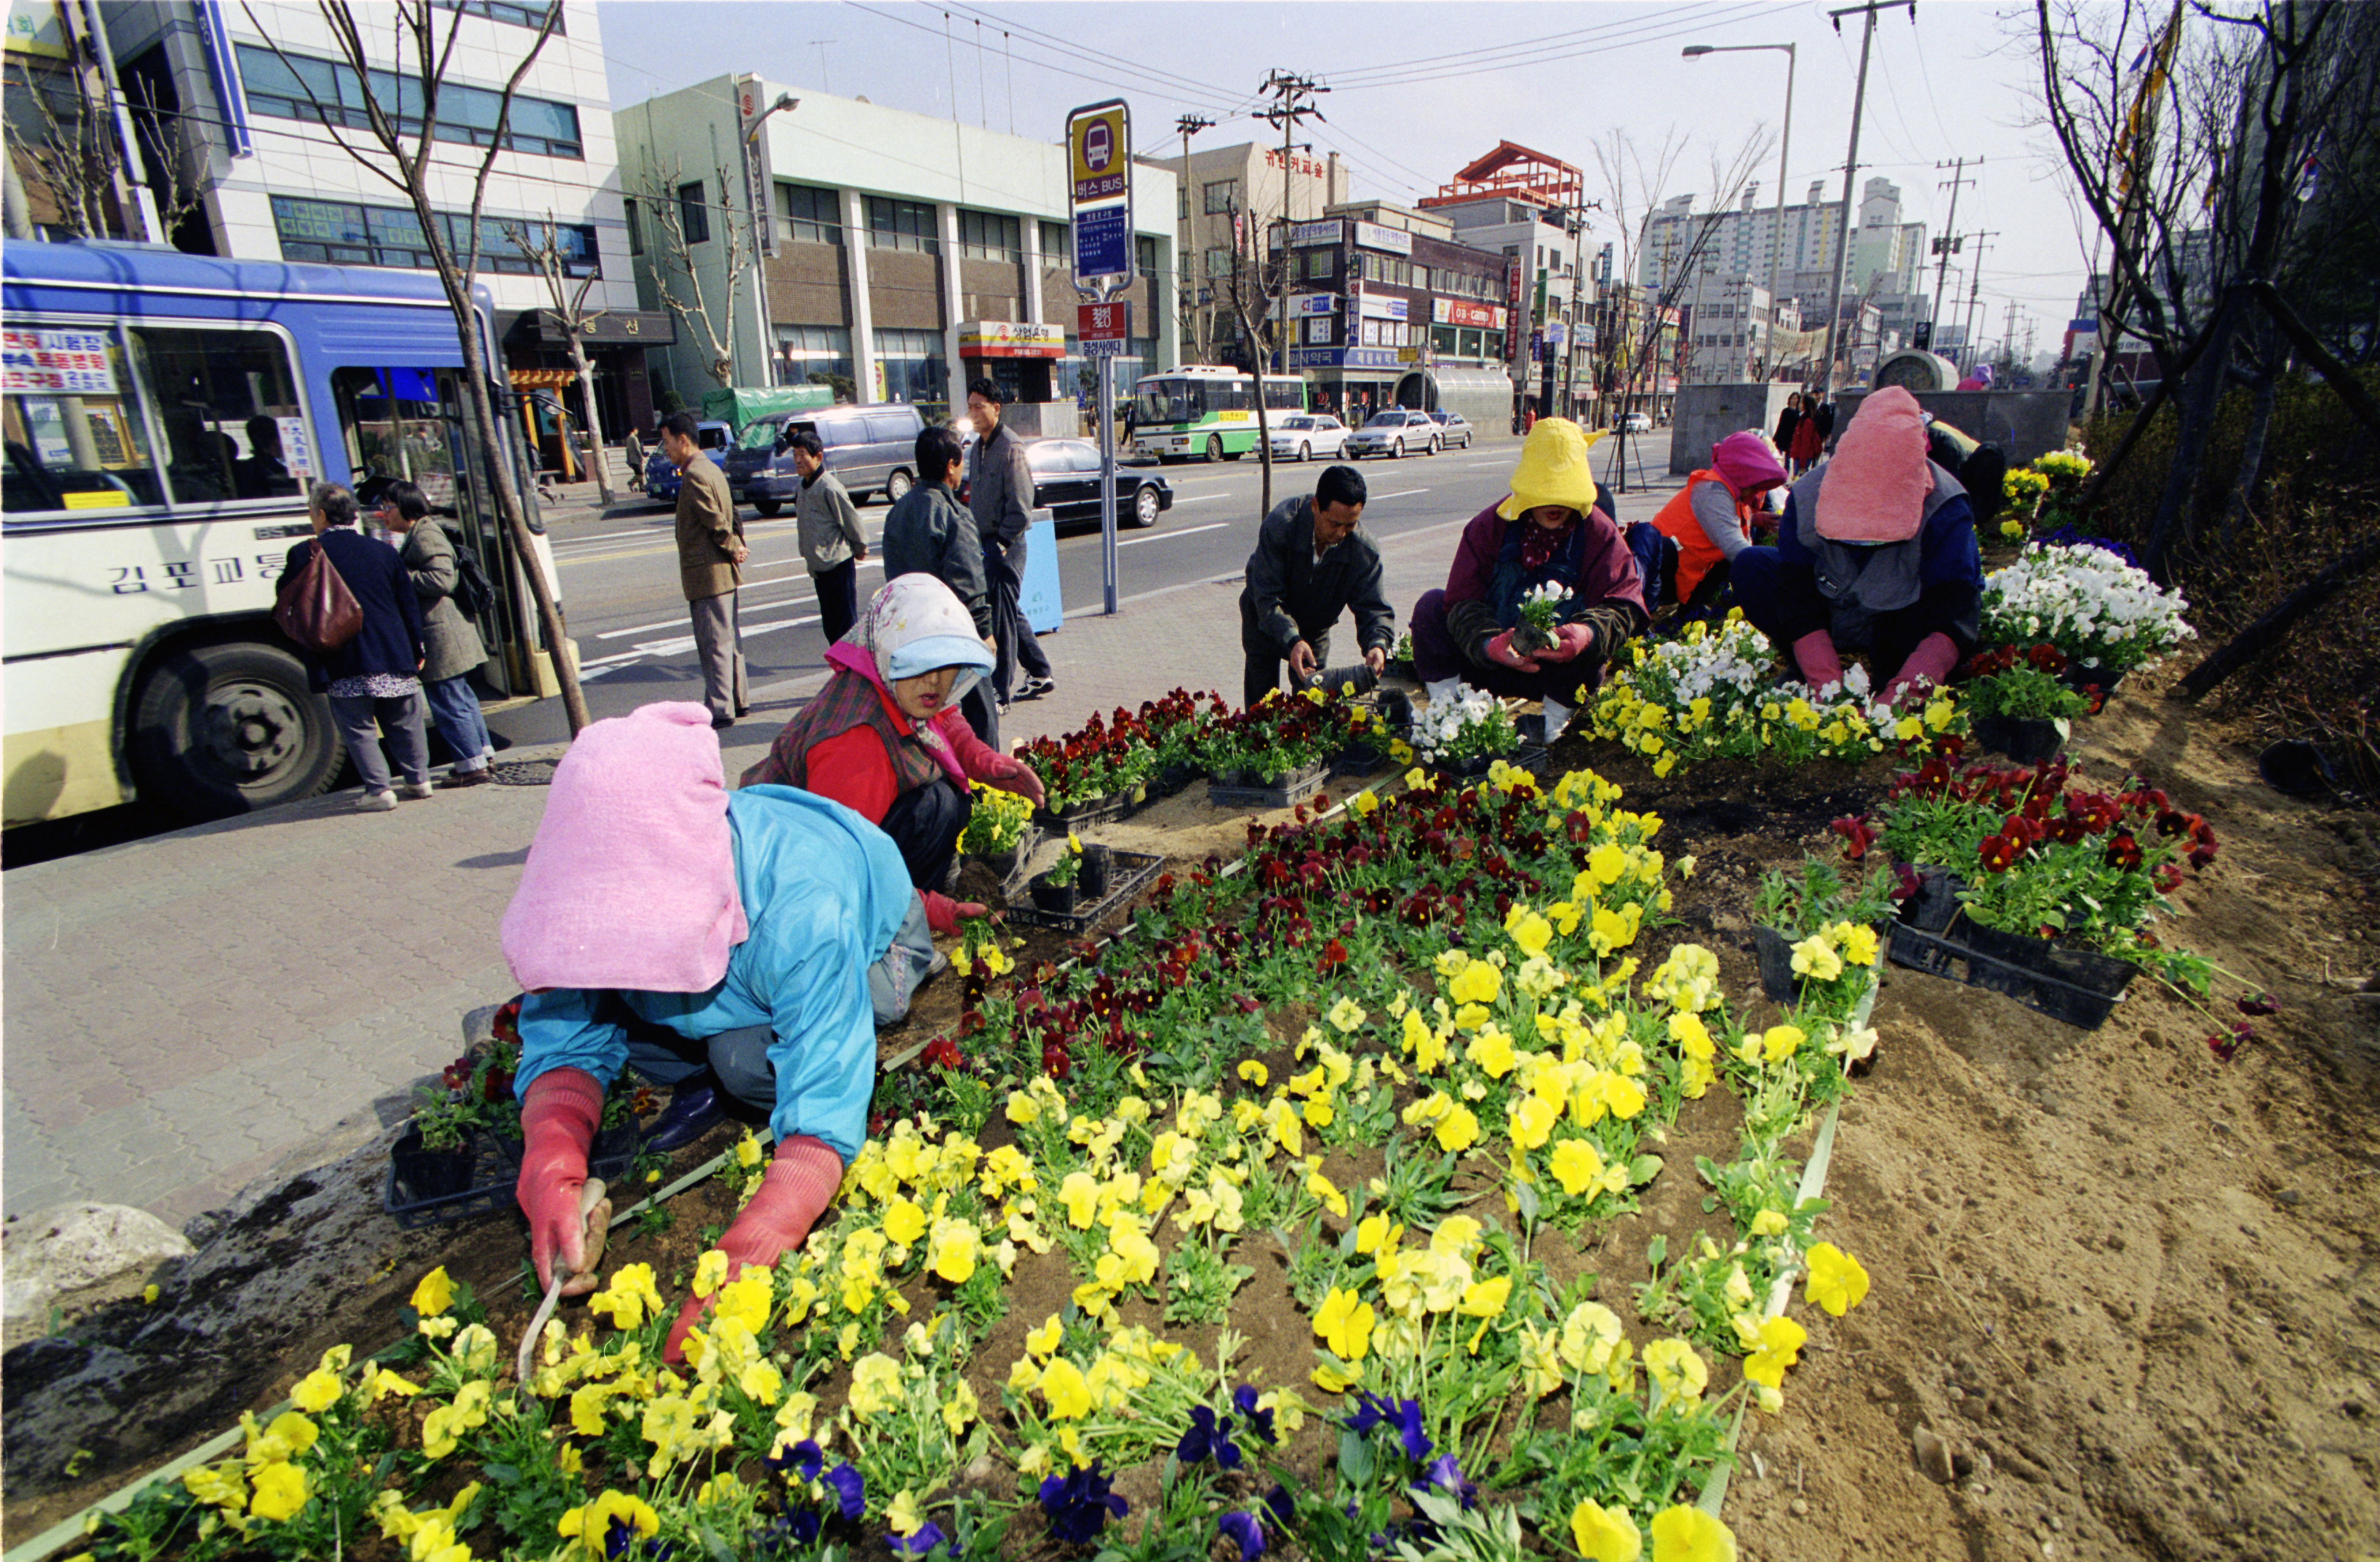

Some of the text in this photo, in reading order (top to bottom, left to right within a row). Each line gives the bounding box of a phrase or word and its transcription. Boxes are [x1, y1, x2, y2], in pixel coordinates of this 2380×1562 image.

[1078, 178, 1123, 198] 버스 BUS
[1013, 326, 1049, 342] 상업은행
[1083, 340, 1121, 356] 칠성사이다
